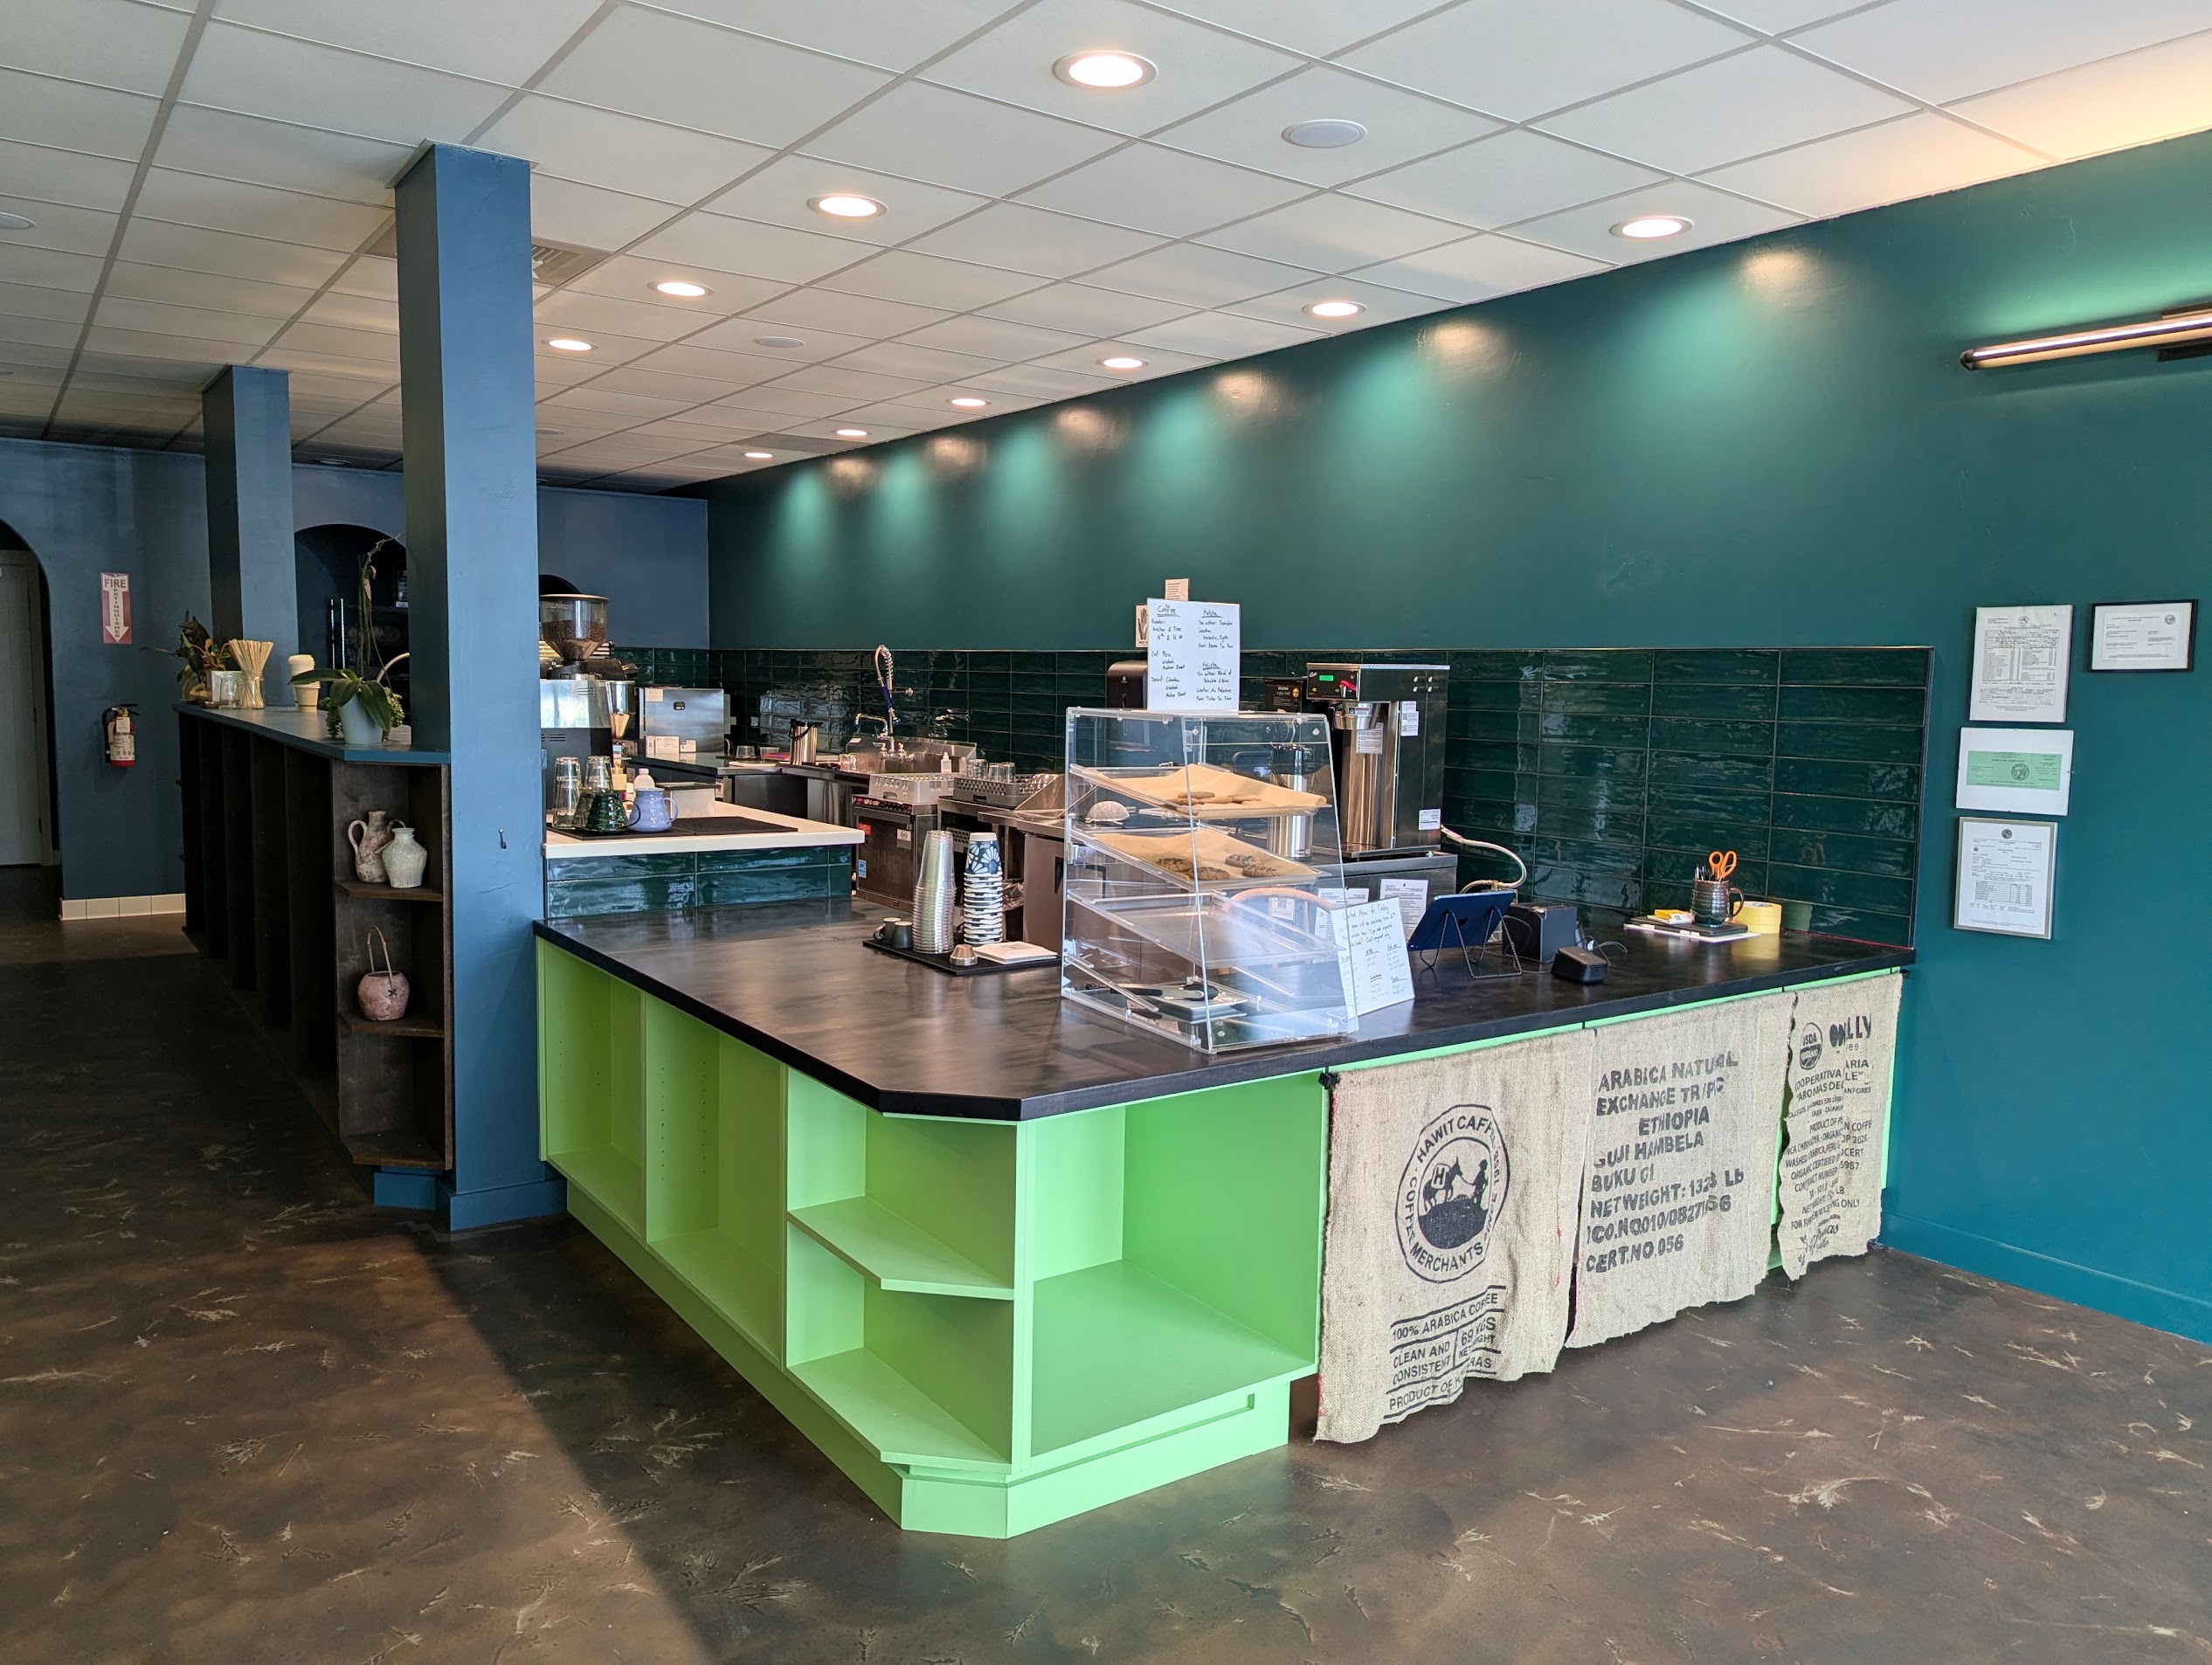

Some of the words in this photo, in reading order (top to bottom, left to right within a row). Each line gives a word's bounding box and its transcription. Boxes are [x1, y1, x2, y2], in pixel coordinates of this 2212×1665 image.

[104, 578, 127, 589] FIRE
[1157, 604, 1176, 614] Coffee
[1802, 1032, 1817, 1047] USDA
[1598, 1065, 1667, 1092] ARABICA
[1845, 1059, 1870, 1069] ARIA
[1596, 1086, 1676, 1117] EXCHANGE
[1638, 1105, 1711, 1136] ETHIOPIA
[1417, 1119, 1455, 1164] HAWIT
[1634, 1130, 1704, 1161] HAMBELA
[1434, 1165, 1446, 1185] H
[1591, 1167, 1636, 1192] BUKU
[1791, 1219, 1803, 1231] FOR
[1841, 1198, 1861, 1208] ONLY
[1409, 1241, 1483, 1272] MERCHANTS
[1393, 1325, 1420, 1343] 100%
[1421, 1309, 1468, 1335] ARABICA
[1461, 1329, 1474, 1346] 69
[1393, 1347, 1426, 1369] CLEAN
[1428, 1341, 1450, 1358] AND
[1393, 1355, 1451, 1385] CONSISTENT
[1389, 1385, 1439, 1411] PRODUCT
[1440, 1381, 1453, 1393] OF
